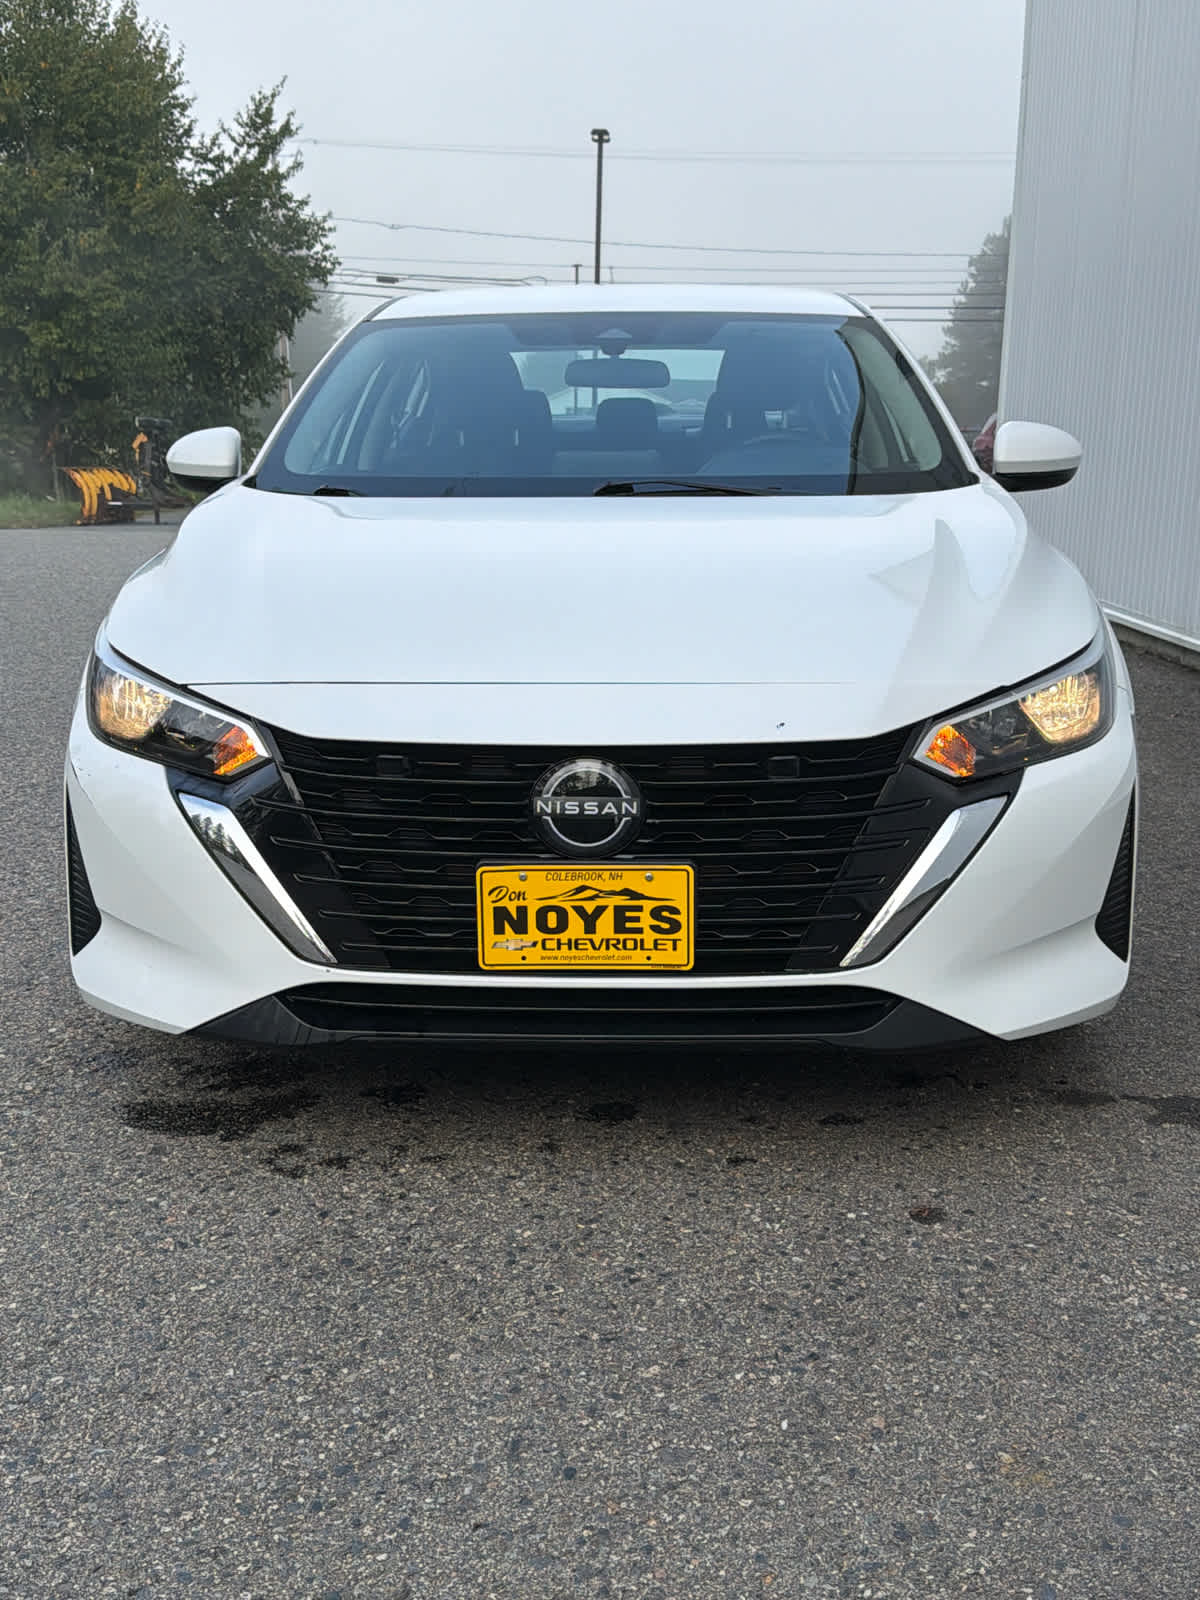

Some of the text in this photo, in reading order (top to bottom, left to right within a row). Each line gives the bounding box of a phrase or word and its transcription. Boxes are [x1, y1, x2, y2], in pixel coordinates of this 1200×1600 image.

[536, 800, 637, 815] NISSAN
[545, 872, 623, 882] COLEBROOK, NH
[487, 885, 527, 903] Don
[493, 905, 682, 935] NOYES
[541, 938, 682, 951] CHEVROLET
[540, 954, 632, 963] www.noyeschevrolet.com
